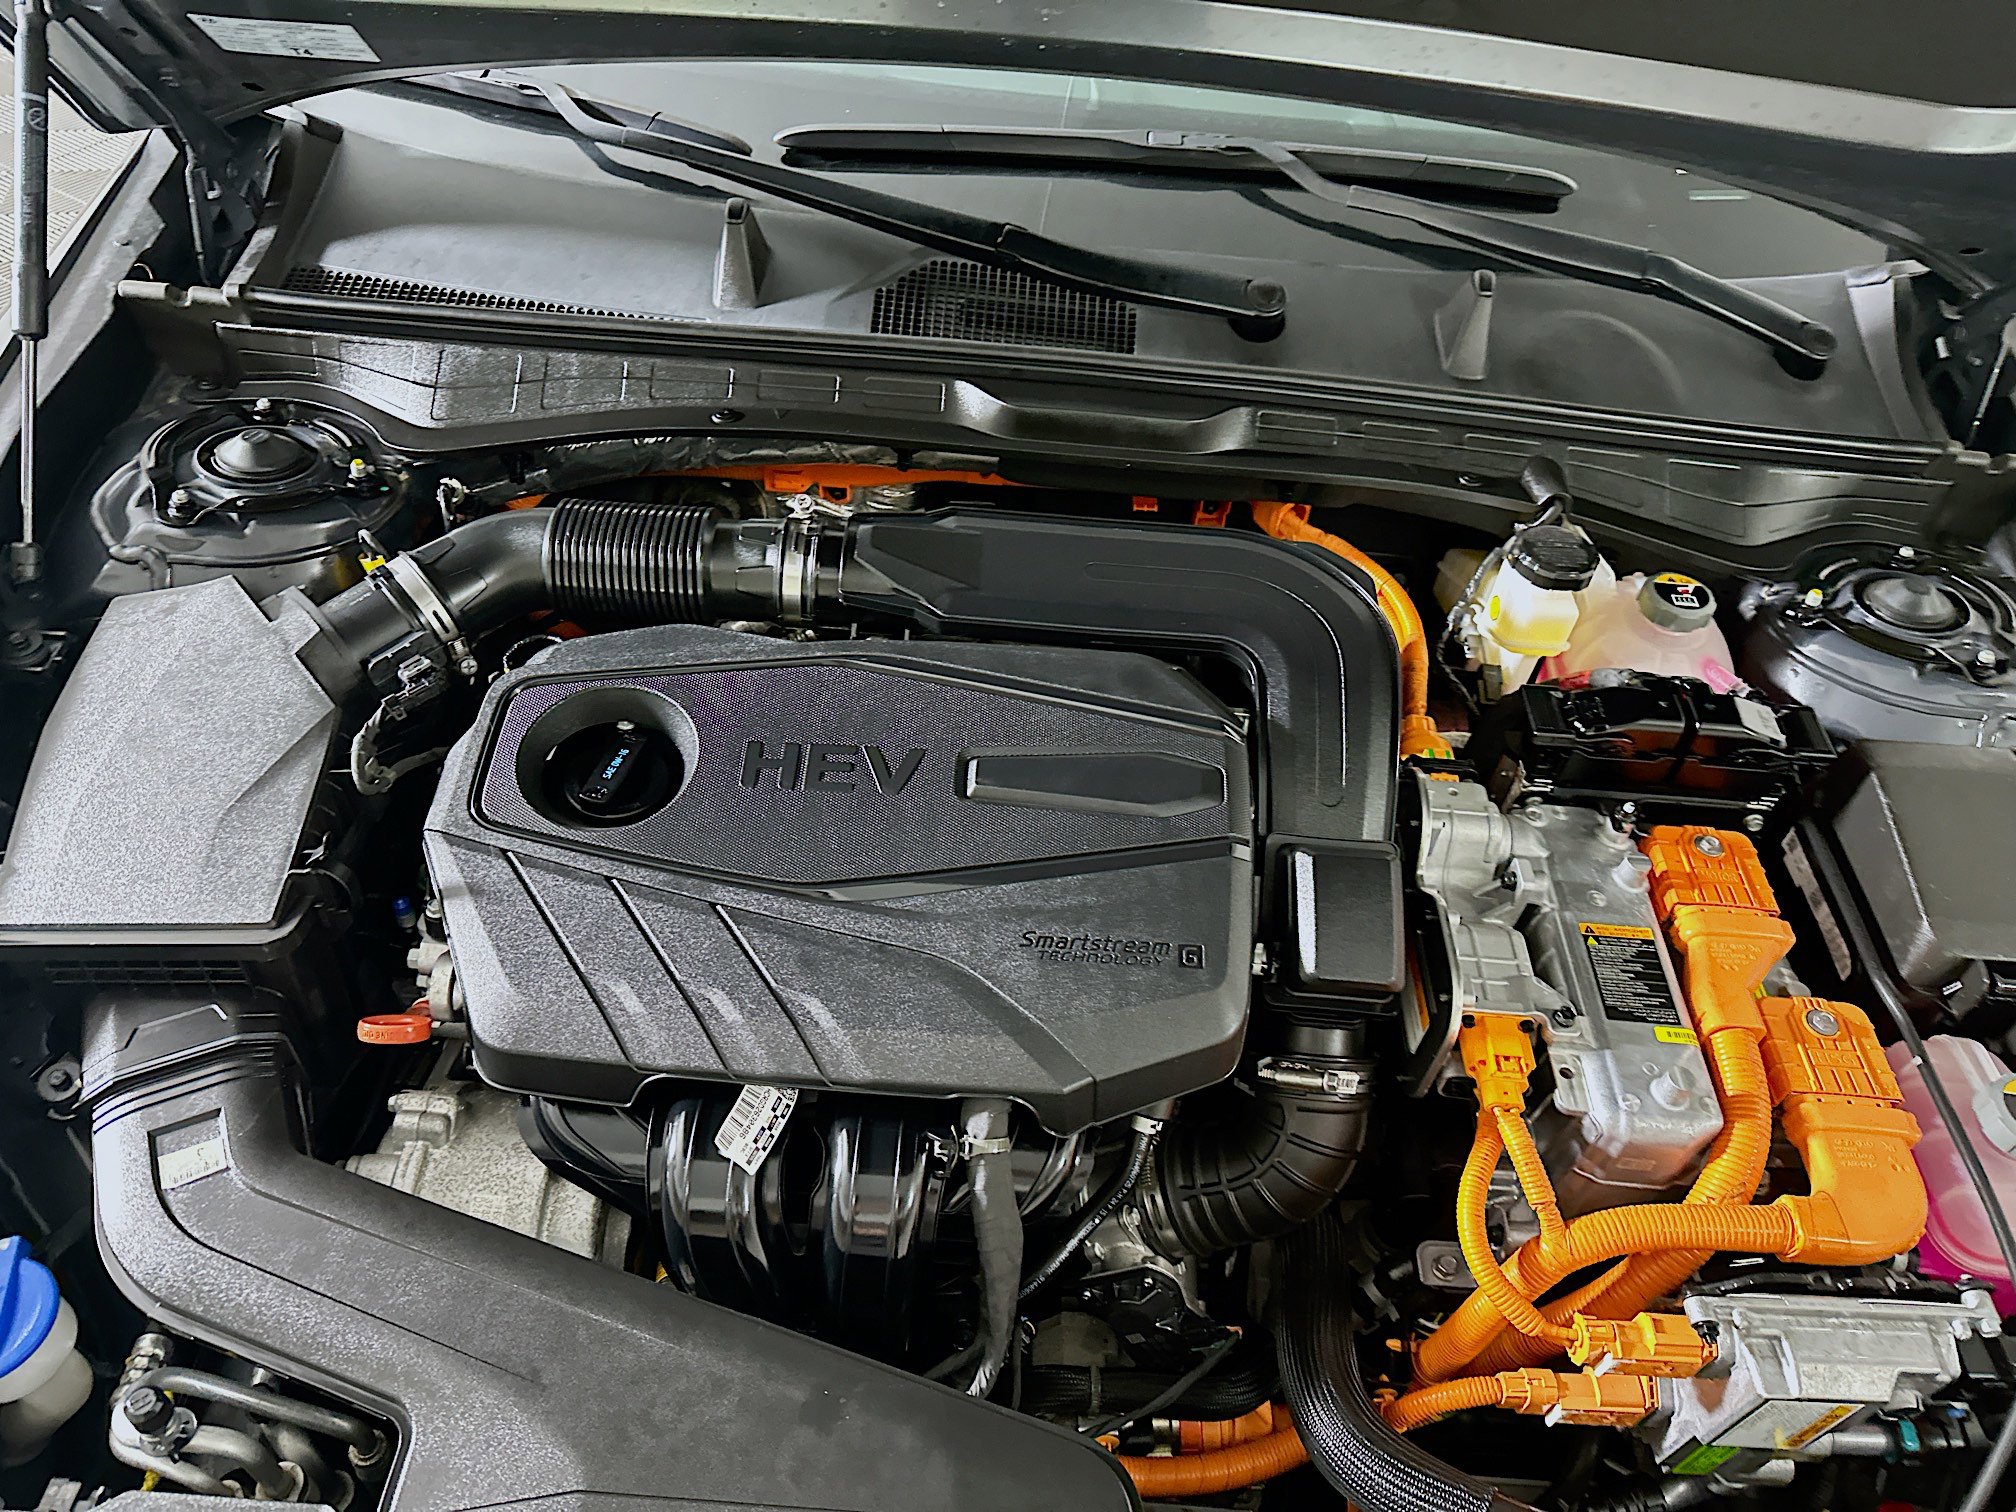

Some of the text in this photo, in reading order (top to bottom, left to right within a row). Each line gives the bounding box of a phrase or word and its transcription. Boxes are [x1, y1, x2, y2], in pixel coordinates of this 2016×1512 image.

[602, 766, 617, 780] SAE
[738, 740, 926, 796] HEV
[1019, 930, 1173, 956] Smartstream
[1038, 950, 1166, 966] TECHNOLOGY
